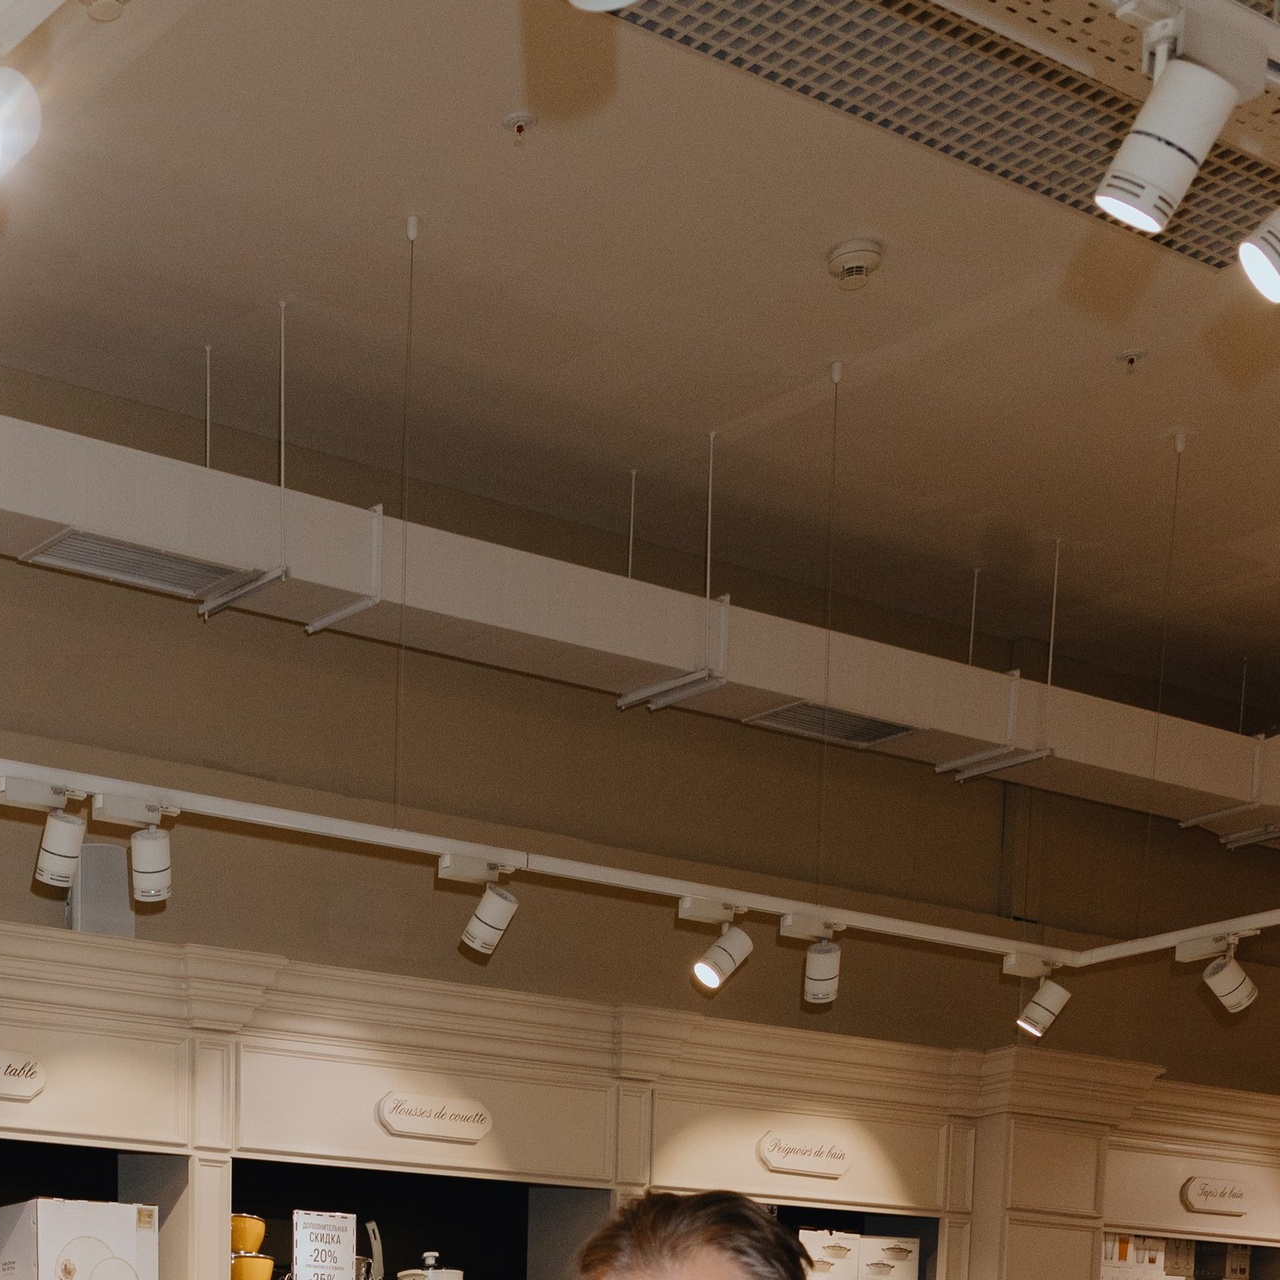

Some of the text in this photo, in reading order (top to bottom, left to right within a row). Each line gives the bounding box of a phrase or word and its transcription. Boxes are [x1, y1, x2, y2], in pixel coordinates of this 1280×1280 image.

[4, 1061, 38, 1079] table
[388, 1098, 488, 1125] Housses de couette
[767, 1138, 846, 1160] Peignoirs de bain
[309, 1231, 341, 1245] СКИДКА
[310, 1248, 338, 1264] -20%
